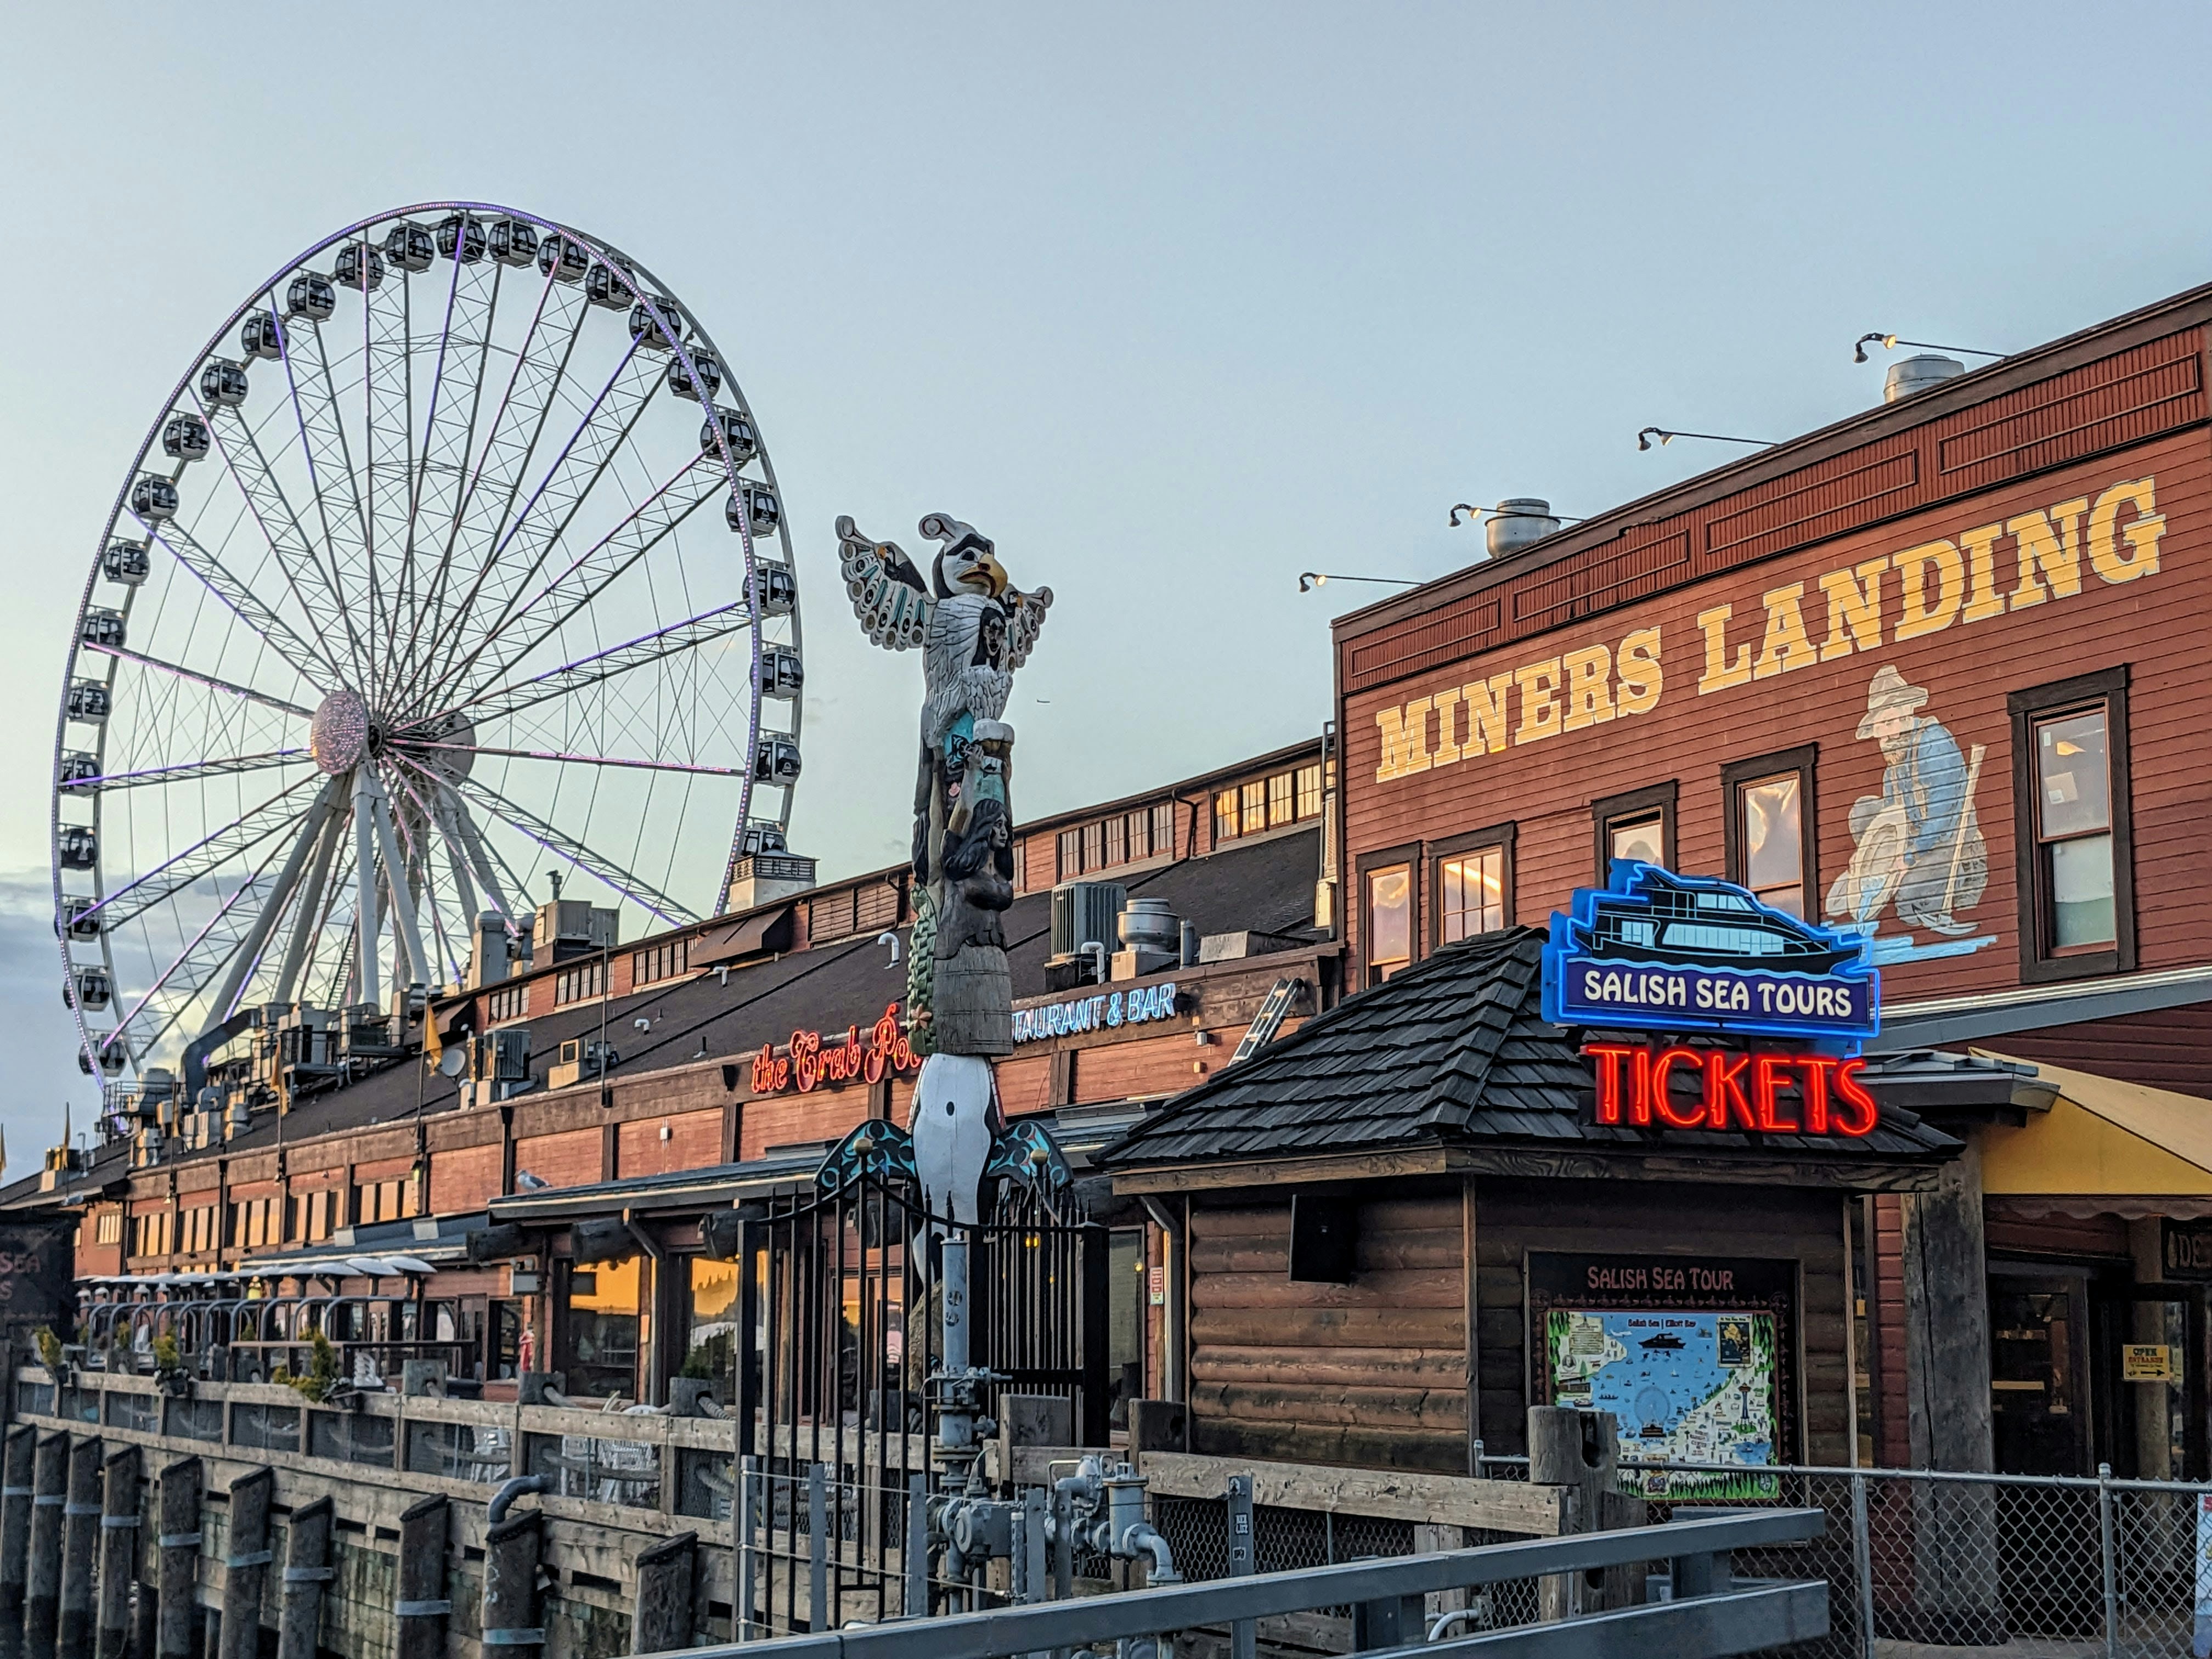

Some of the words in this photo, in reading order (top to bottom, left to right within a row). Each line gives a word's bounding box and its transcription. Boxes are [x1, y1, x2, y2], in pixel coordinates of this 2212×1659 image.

[1375, 625, 1663, 783] MINERS
[1697, 476, 2166, 696] LANDING
[1012, 995, 1106, 1042] TAURANT
[1107, 991, 1123, 1026] &
[1127, 983, 1176, 1022] BAR
[1584, 970, 1686, 1007] SALISH
[1696, 978, 1750, 1011] SEA
[1758, 983, 1852, 1017] TOURS
[751, 1043, 789, 1093] the
[790, 1024, 862, 1093] Crab
[1584, 1043, 1878, 1137] TICKETS
[1587, 1265, 1648, 1290] SALISH
[1652, 1266, 1686, 1290] SEA
[1688, 1267, 1734, 1291] TOUR
